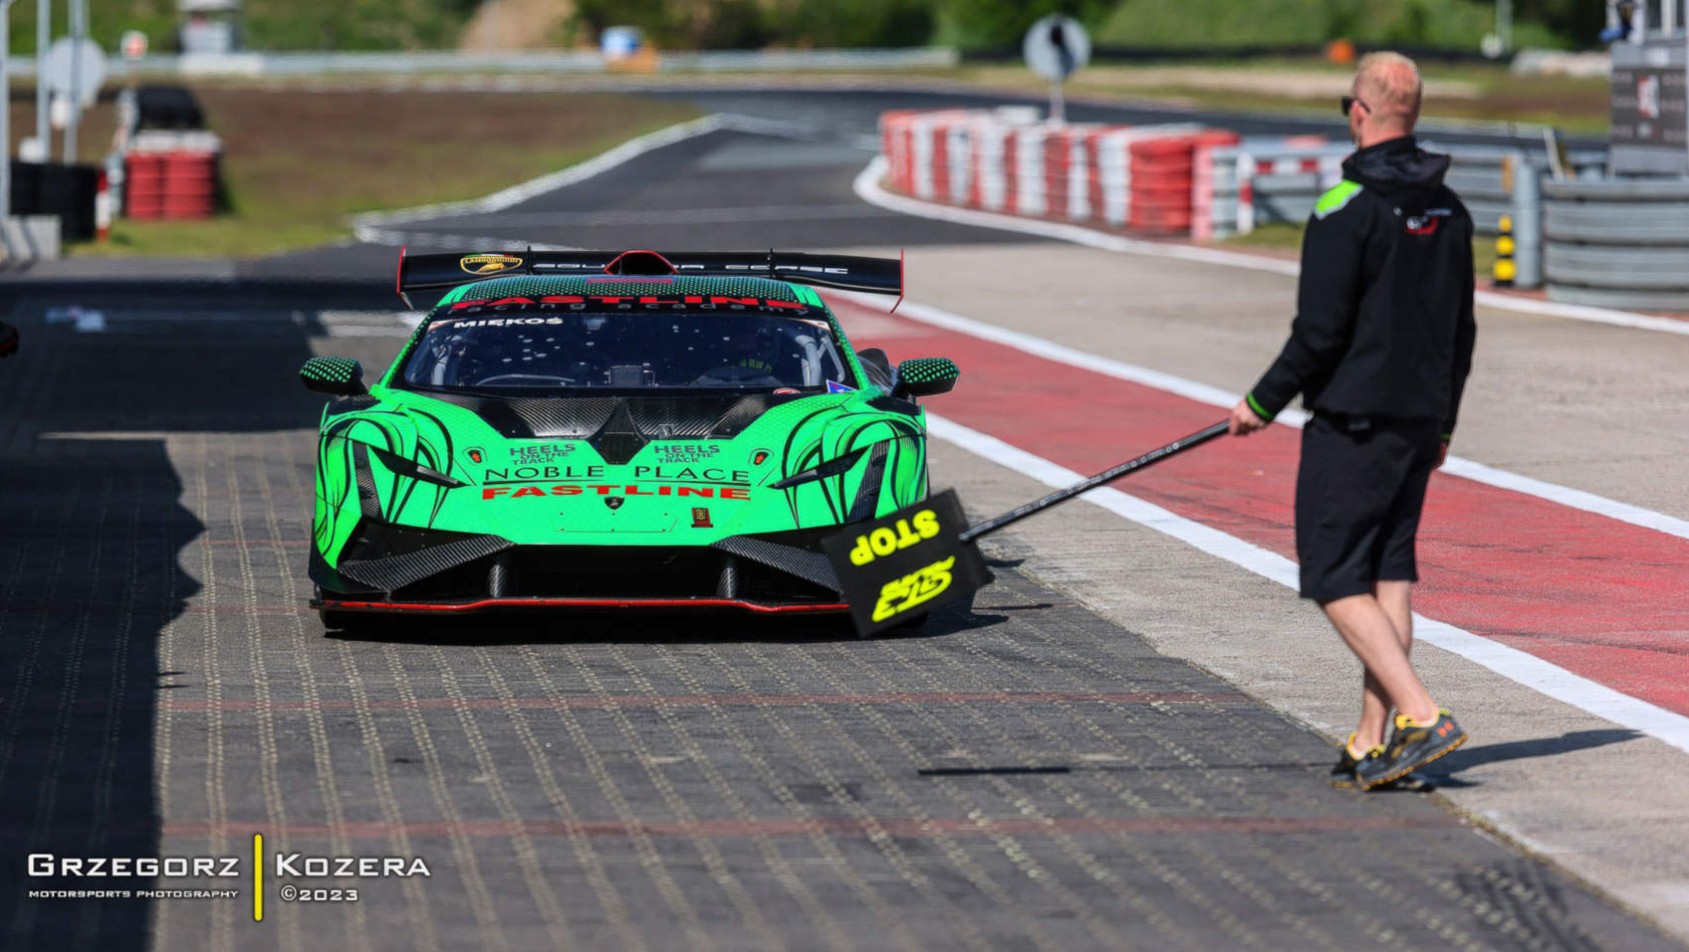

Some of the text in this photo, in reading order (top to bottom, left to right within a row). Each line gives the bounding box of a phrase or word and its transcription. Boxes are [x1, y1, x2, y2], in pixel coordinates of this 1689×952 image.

[451, 295, 808, 310] FASTLINE
[509, 443, 576, 456] HEELS
[520, 450, 569, 460] ON THE
[654, 445, 720, 454] HEELS
[512, 456, 555, 466] TRACK
[485, 465, 749, 482] NOBLE PLACE
[482, 484, 751, 501] FASTLINE
[849, 509, 941, 566] STOP
